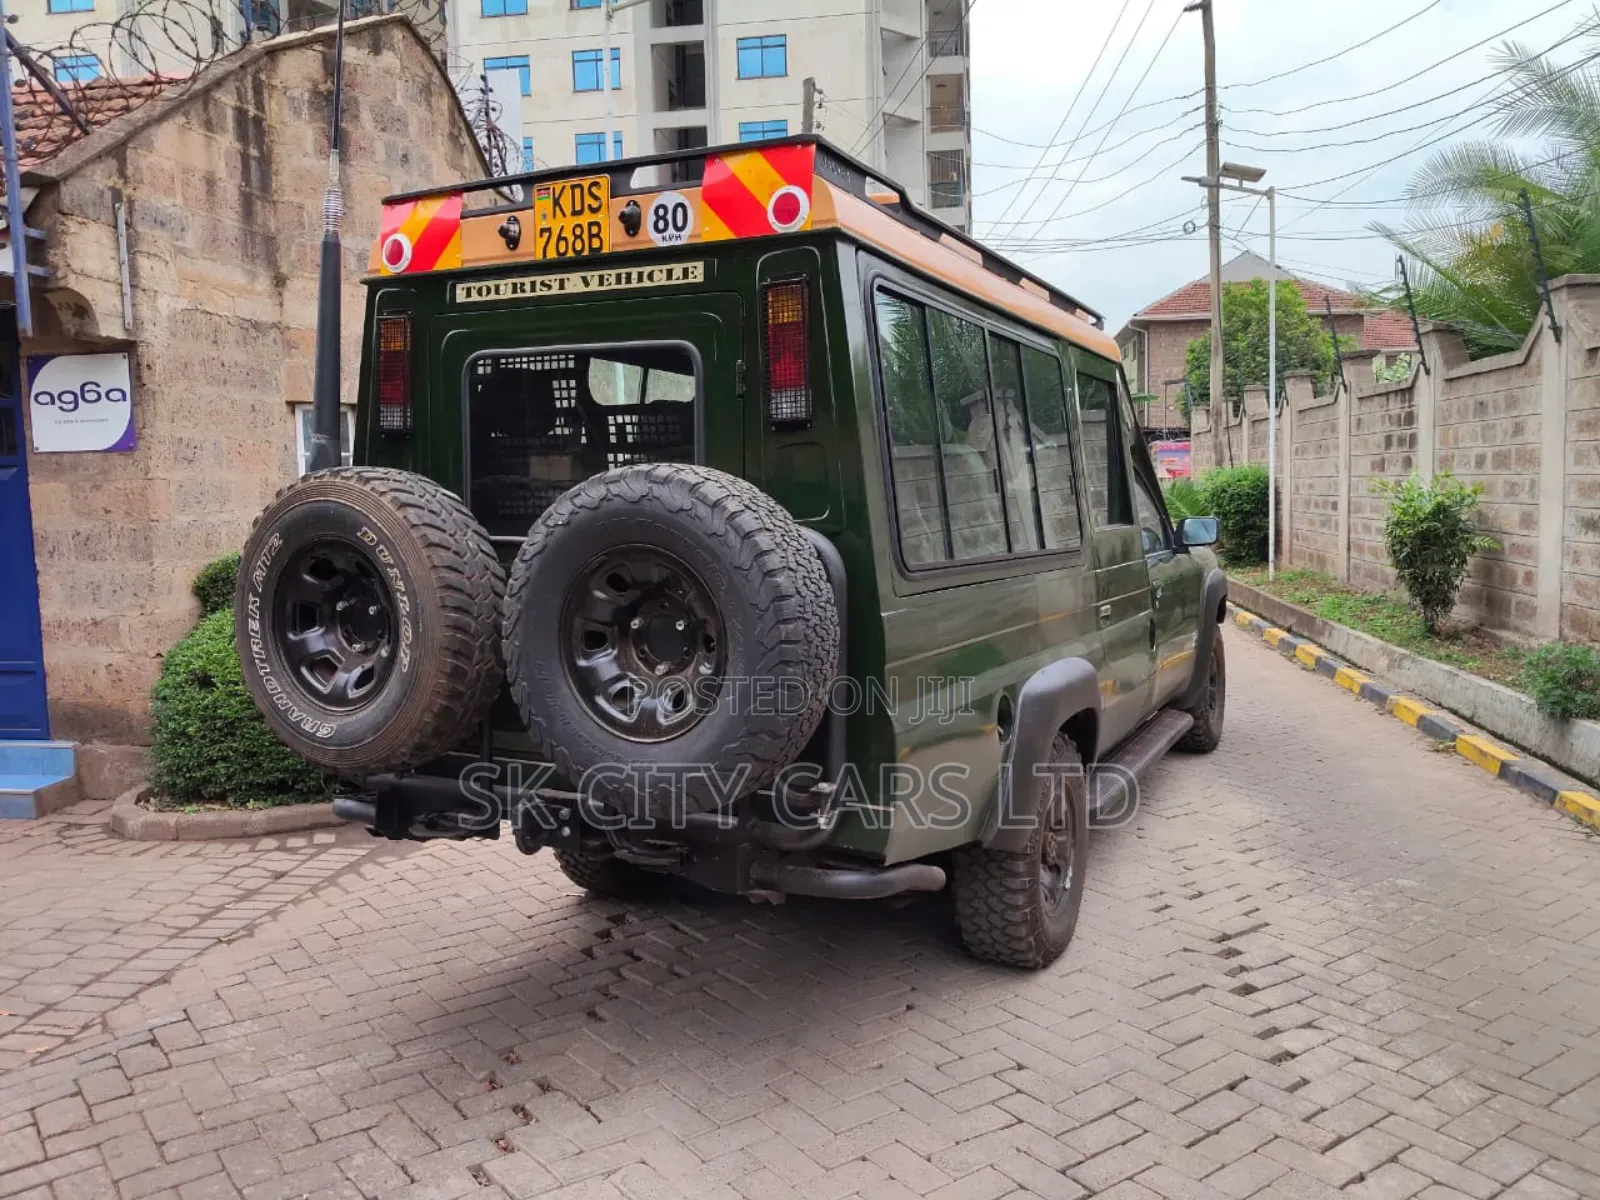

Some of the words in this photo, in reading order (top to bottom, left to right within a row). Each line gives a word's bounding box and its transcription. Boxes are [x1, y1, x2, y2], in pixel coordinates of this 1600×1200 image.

[551, 180, 603, 220] KDS
[653, 201, 689, 235] 80
[539, 220, 604, 260] 768B
[660, 233, 683, 243] KPH
[460, 275, 571, 299] TOURIST
[579, 264, 698, 289] VEHICLE
[356, 526, 413, 673] DUNLOP
[247, 592, 337, 739] GRANDTREK
